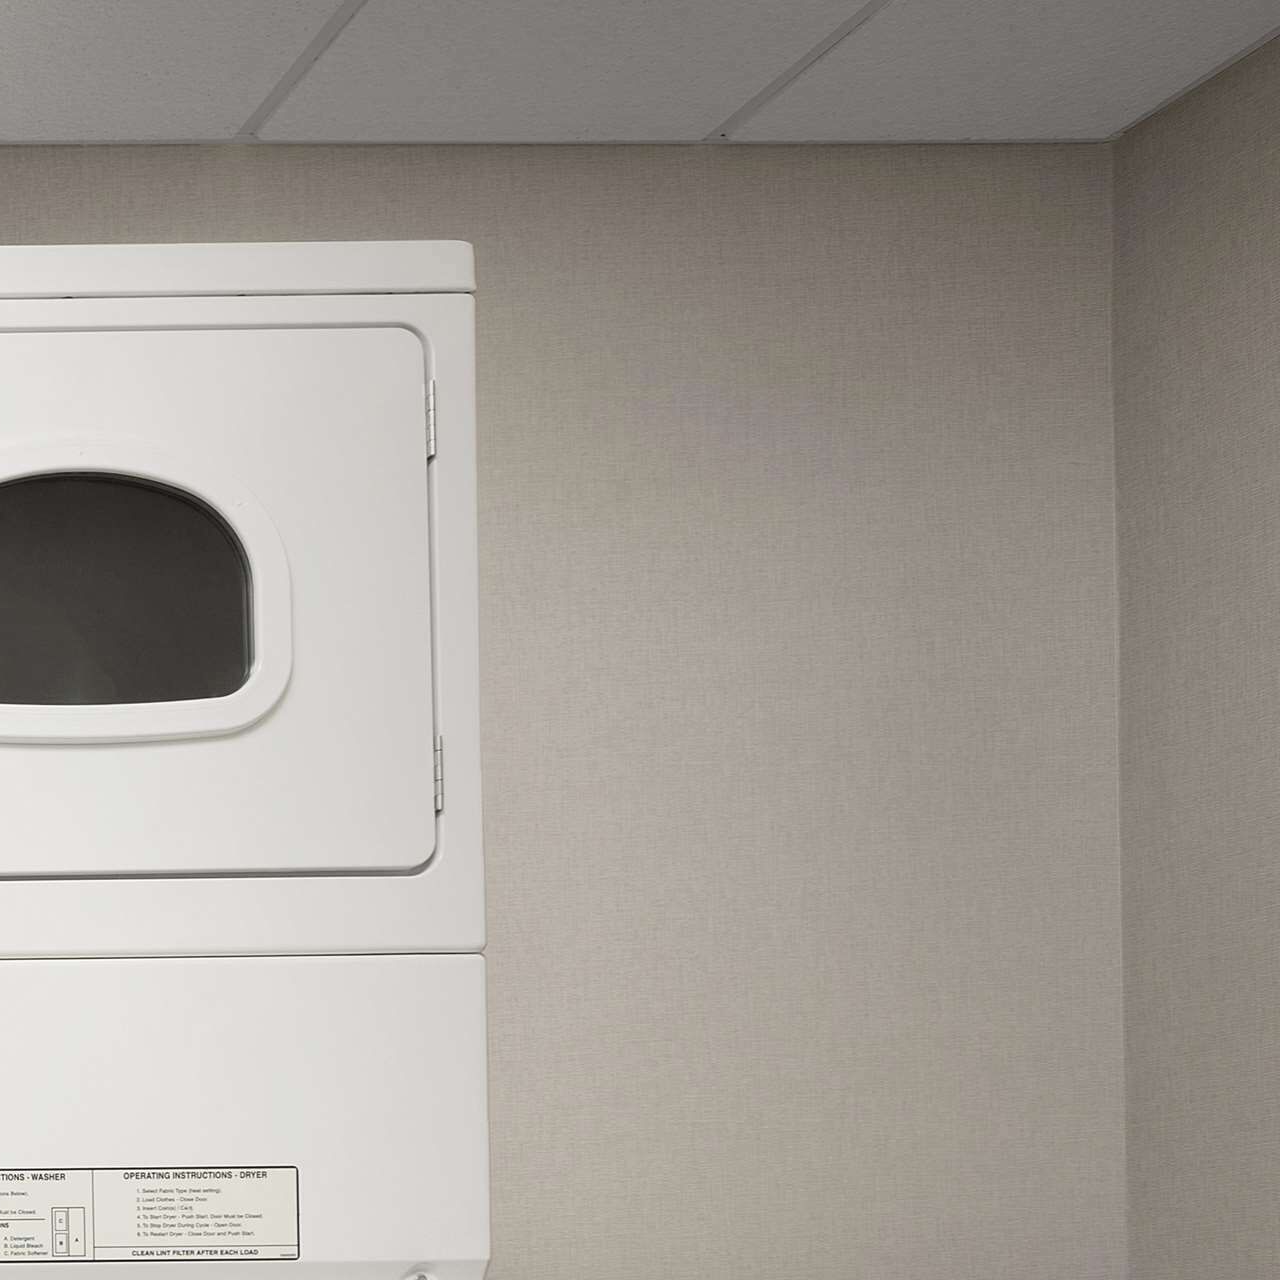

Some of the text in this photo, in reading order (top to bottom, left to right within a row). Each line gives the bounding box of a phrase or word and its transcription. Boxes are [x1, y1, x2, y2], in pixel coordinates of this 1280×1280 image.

[31, 1173, 66, 1181] WASHER
[123, 1171, 268, 1180] OPERATING INSTRUCTIONS DRYER
